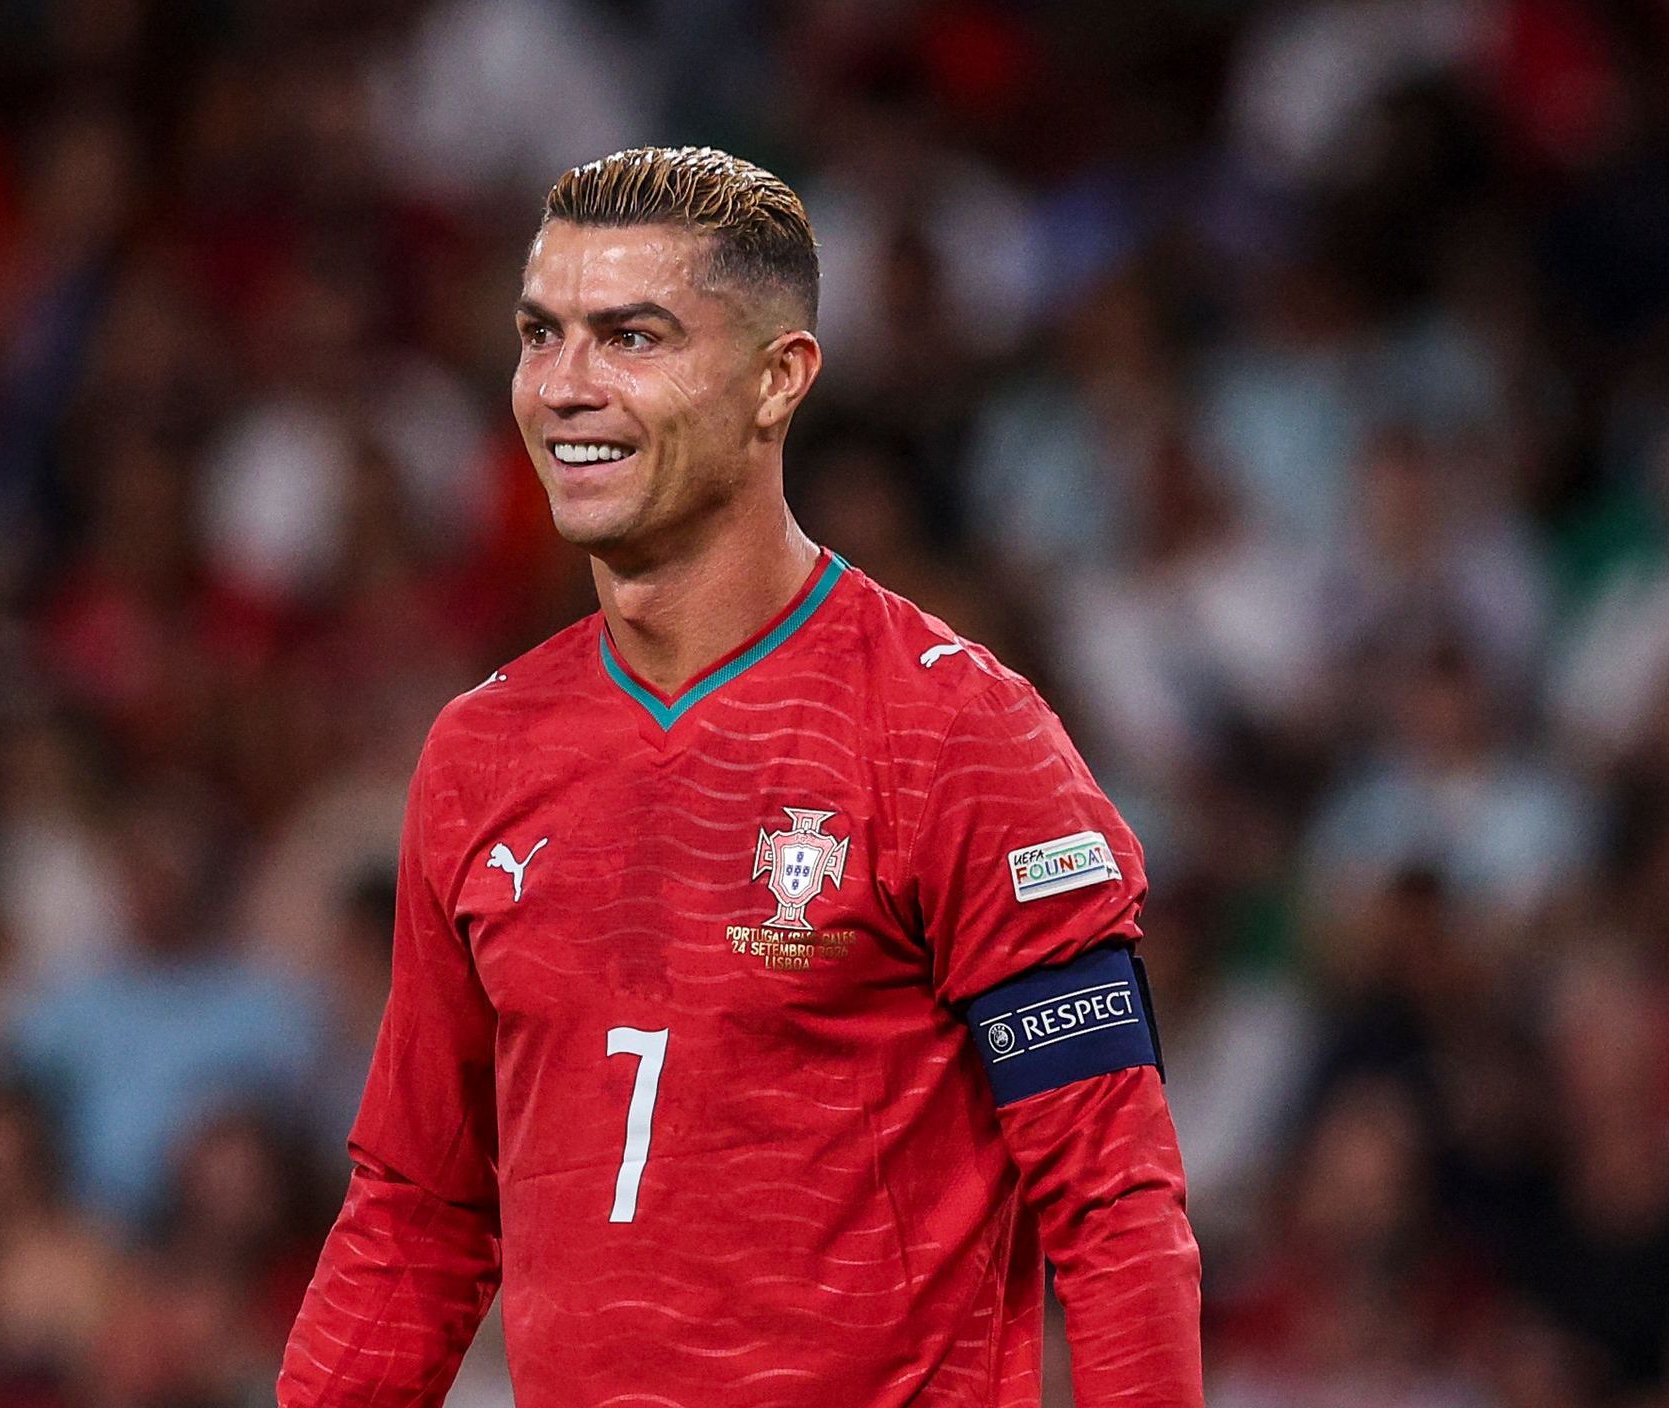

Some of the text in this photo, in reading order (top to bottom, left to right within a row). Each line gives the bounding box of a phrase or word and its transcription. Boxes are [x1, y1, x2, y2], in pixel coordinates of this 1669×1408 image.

[1014, 849, 1044, 866] UEFA
[726, 926, 785, 943] PORTUGAL
[731, 940, 746, 954] 24
[750, 942, 815, 958] SETEMBRO
[765, 956, 811, 969] LISBOA
[1021, 991, 1134, 1041] RESPECT
[606, 1026, 669, 1223] 7
